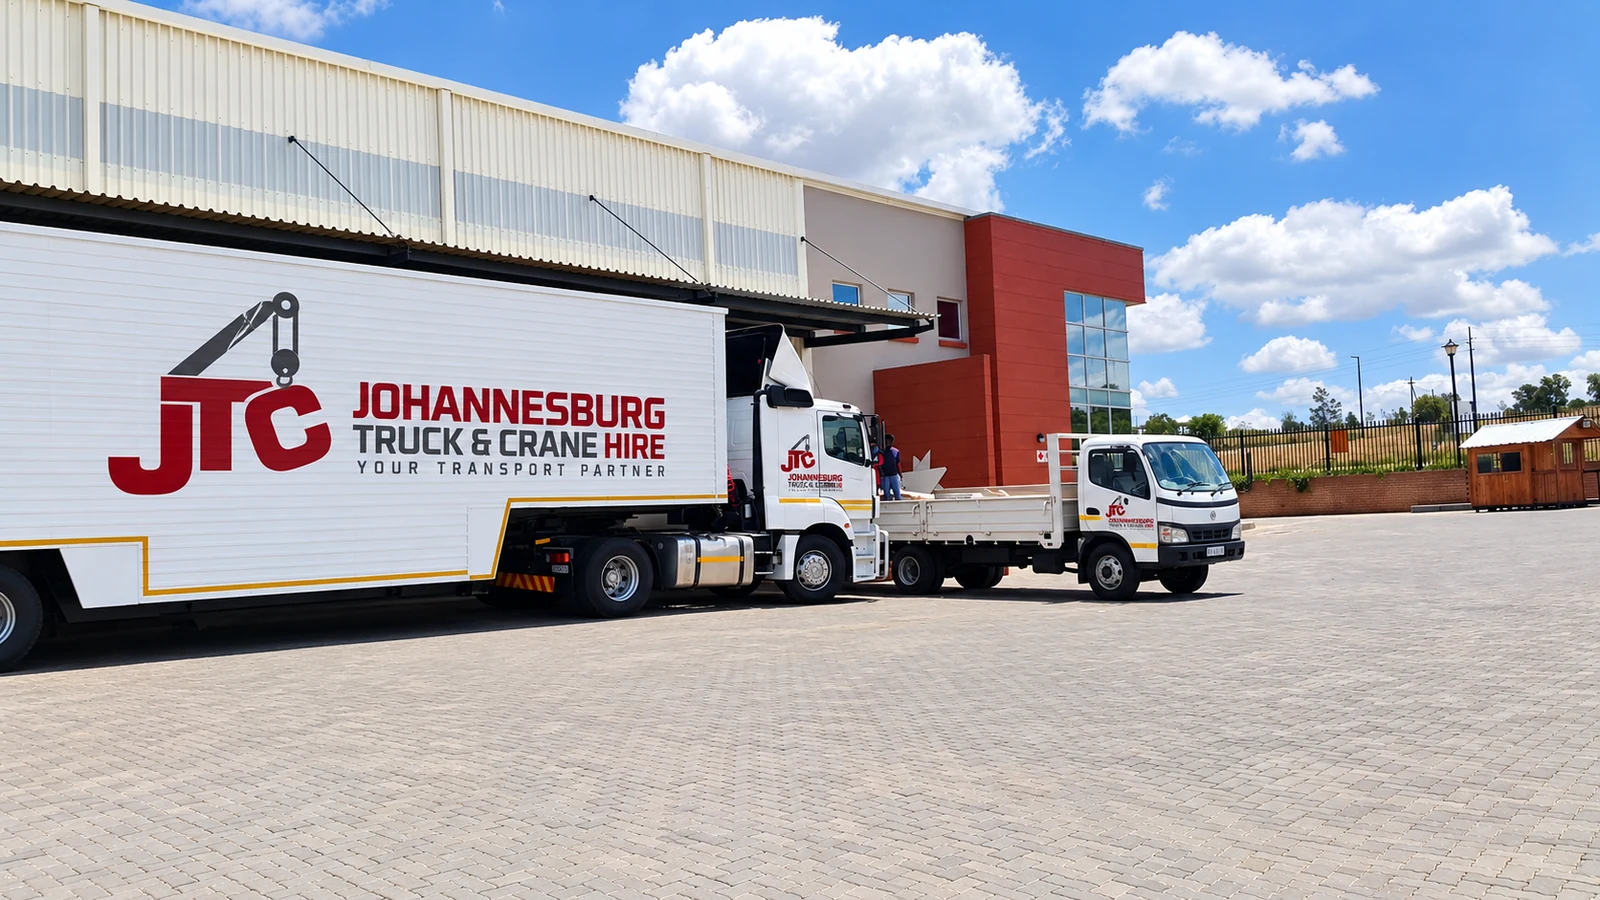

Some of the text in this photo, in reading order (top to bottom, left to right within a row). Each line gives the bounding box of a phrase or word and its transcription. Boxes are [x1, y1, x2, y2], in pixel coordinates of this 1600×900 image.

[352, 381, 665, 430] JOHANNESBURG
[108, 376, 332, 496] JTC
[352, 424, 665, 460] TRUCK & CRANE HIRE
[357, 460, 665, 477] YOUR TRANSPORT PARTNER
[780, 449, 816, 472] JTC
[1105, 505, 1126, 518] JTC
